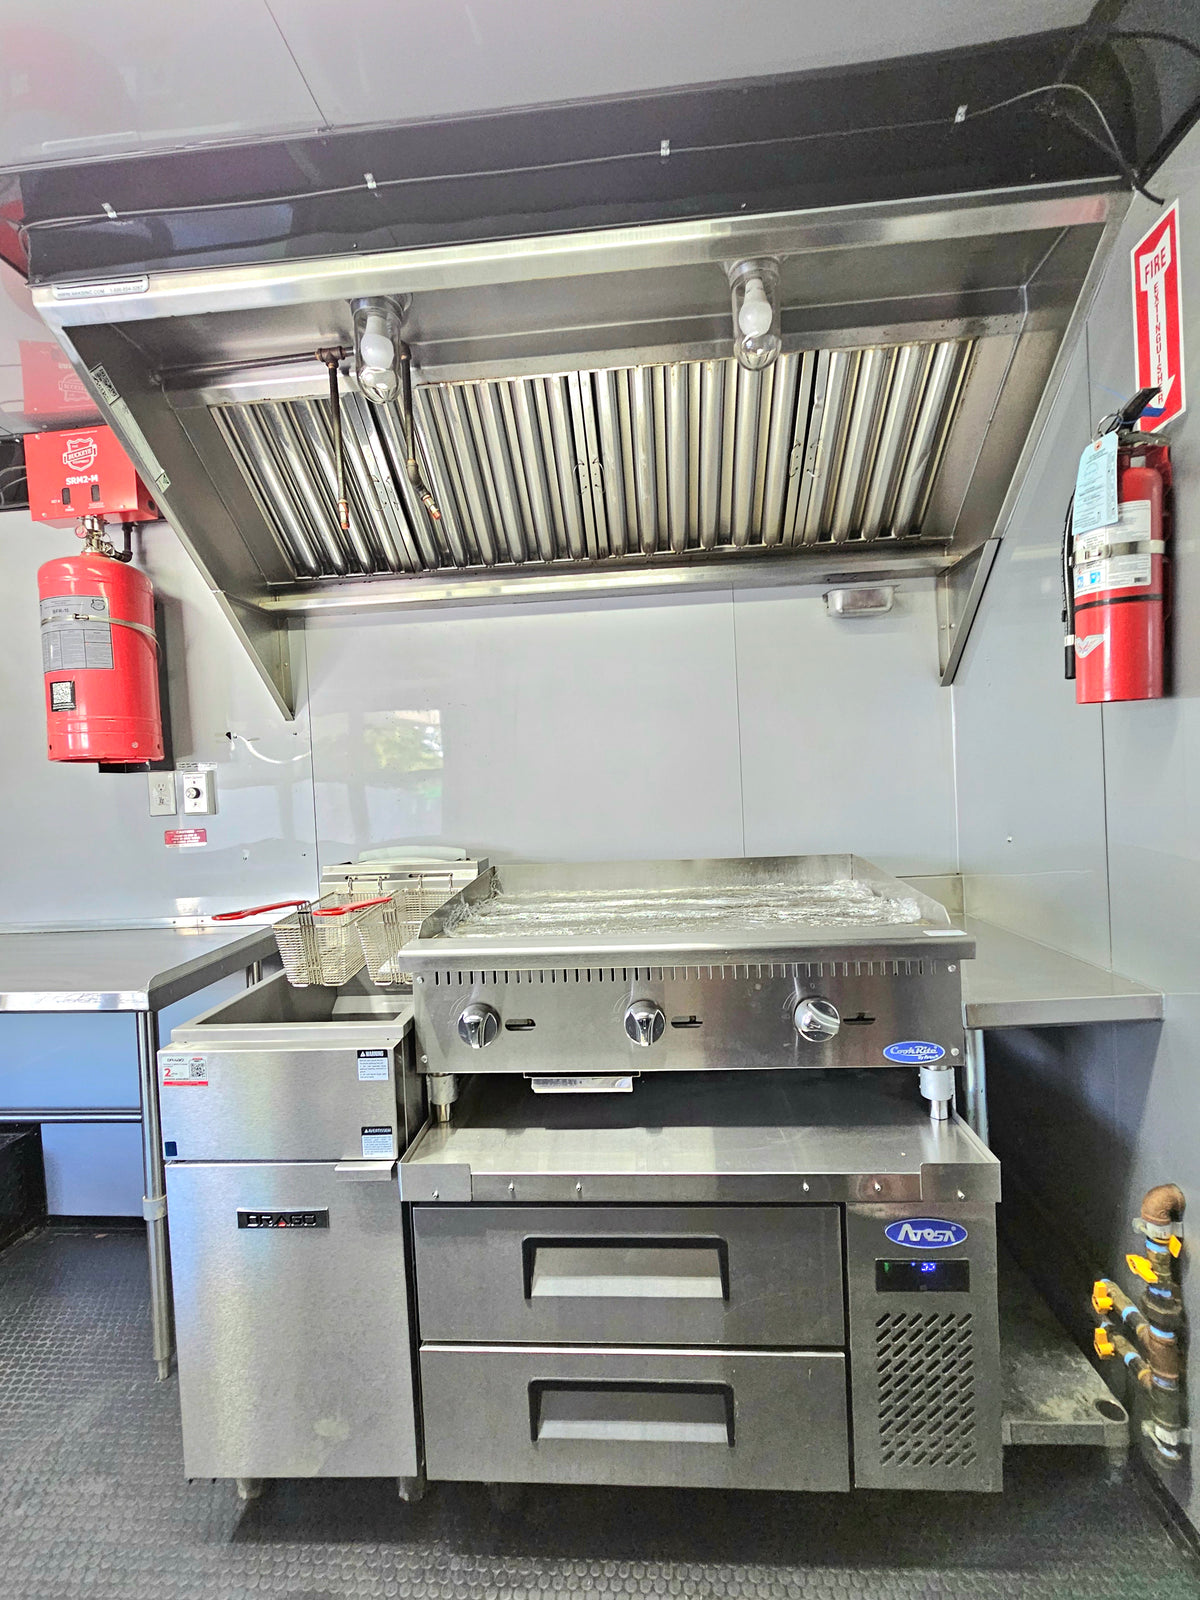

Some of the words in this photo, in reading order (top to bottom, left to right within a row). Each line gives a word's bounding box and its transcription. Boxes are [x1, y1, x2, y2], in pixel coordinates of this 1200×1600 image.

[1144, 246, 1167, 284] FIRE
[66, 474, 99, 485] SRM2-M
[890, 1045, 938, 1055] CookRite
[164, 1067, 172, 1077] 2
[247, 1214, 317, 1228] DRAGO
